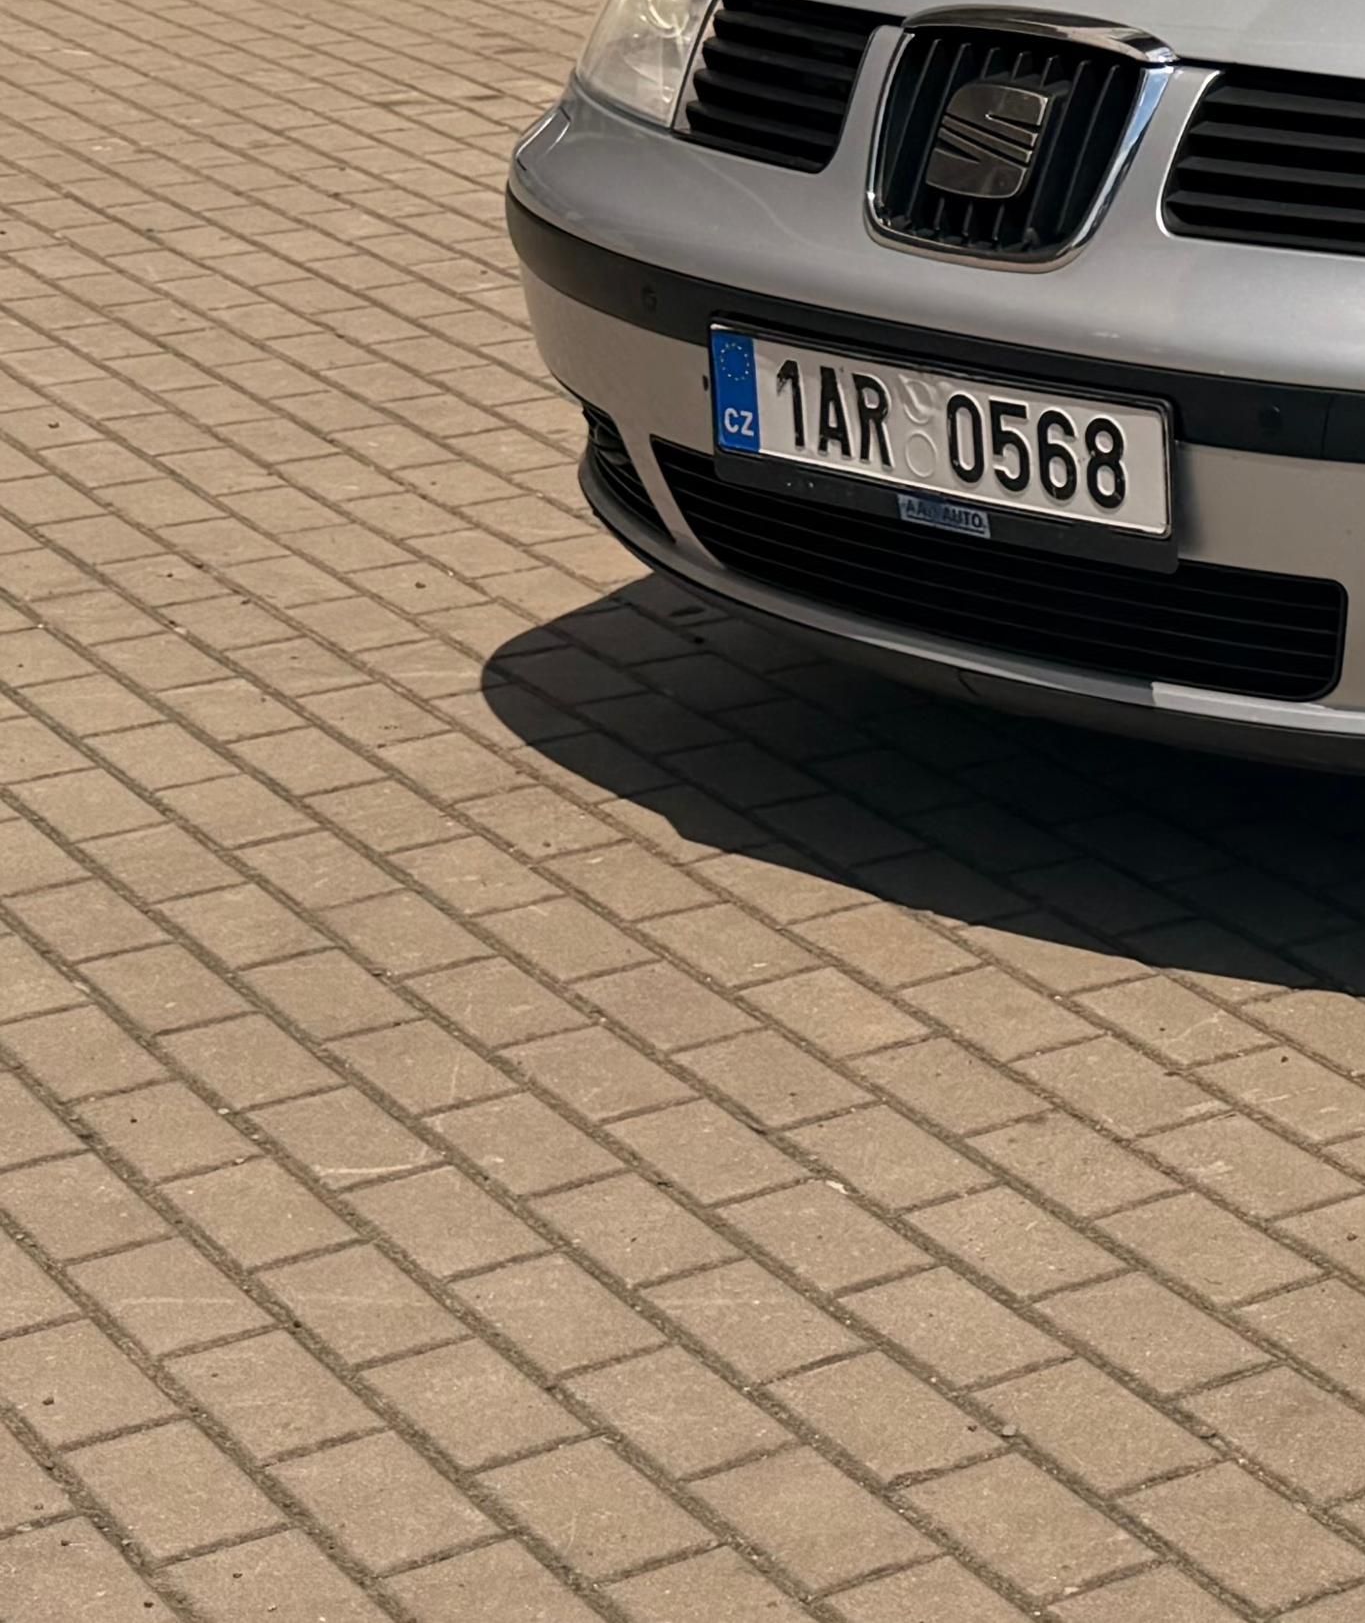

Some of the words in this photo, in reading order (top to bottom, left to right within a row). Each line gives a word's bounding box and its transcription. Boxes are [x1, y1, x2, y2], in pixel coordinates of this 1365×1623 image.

[724, 408, 755, 437] CZ
[776, 359, 895, 471] 1AR
[946, 392, 1127, 510] 0568
